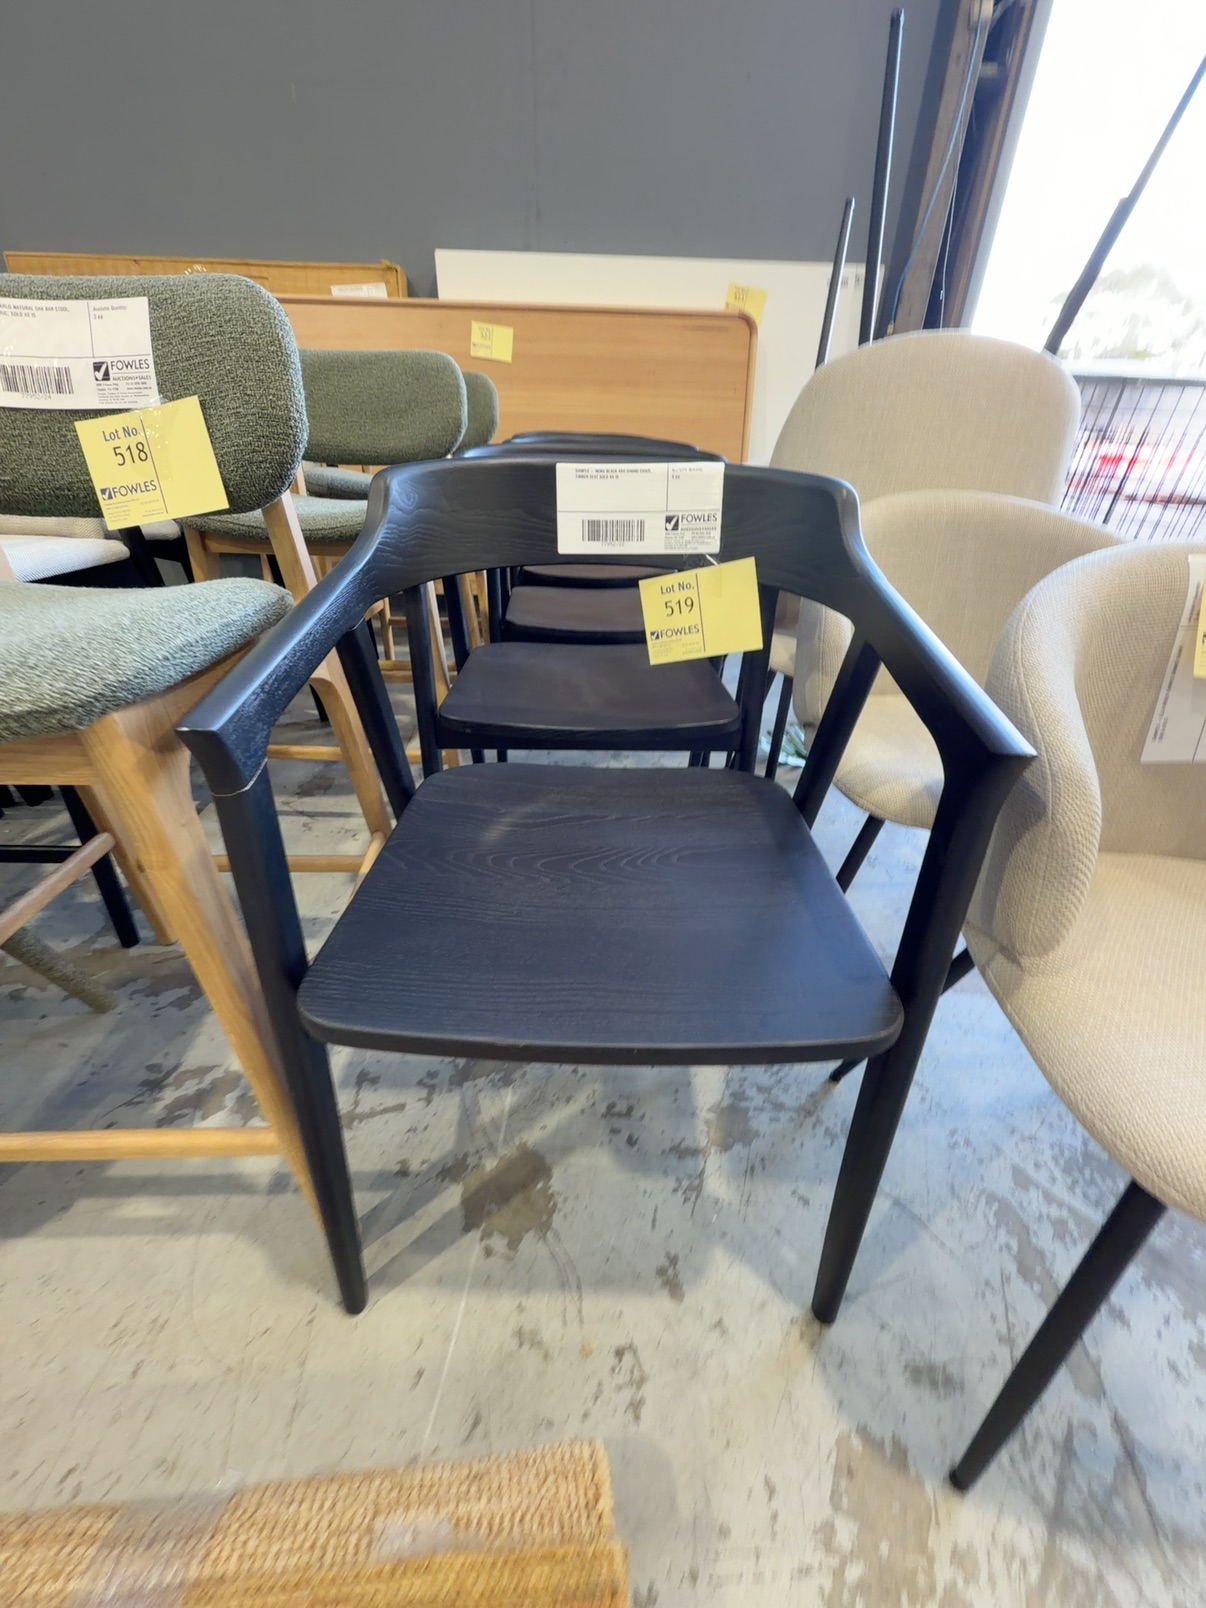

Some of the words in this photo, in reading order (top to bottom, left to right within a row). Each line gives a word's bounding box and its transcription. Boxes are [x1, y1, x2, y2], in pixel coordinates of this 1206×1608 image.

[111, 359, 150, 371] FOWLES
[102, 429, 121, 442] Lot
[122, 425, 140, 438] No.
[113, 441, 148, 467] 518
[112, 480, 157, 499] FOWLES
[681, 512, 718, 523] FOWLES
[660, 584, 675, 595] Lot
[678, 581, 695, 591] No.
[664, 596, 694, 617] 519
[659, 624, 700, 639] FOWLES
